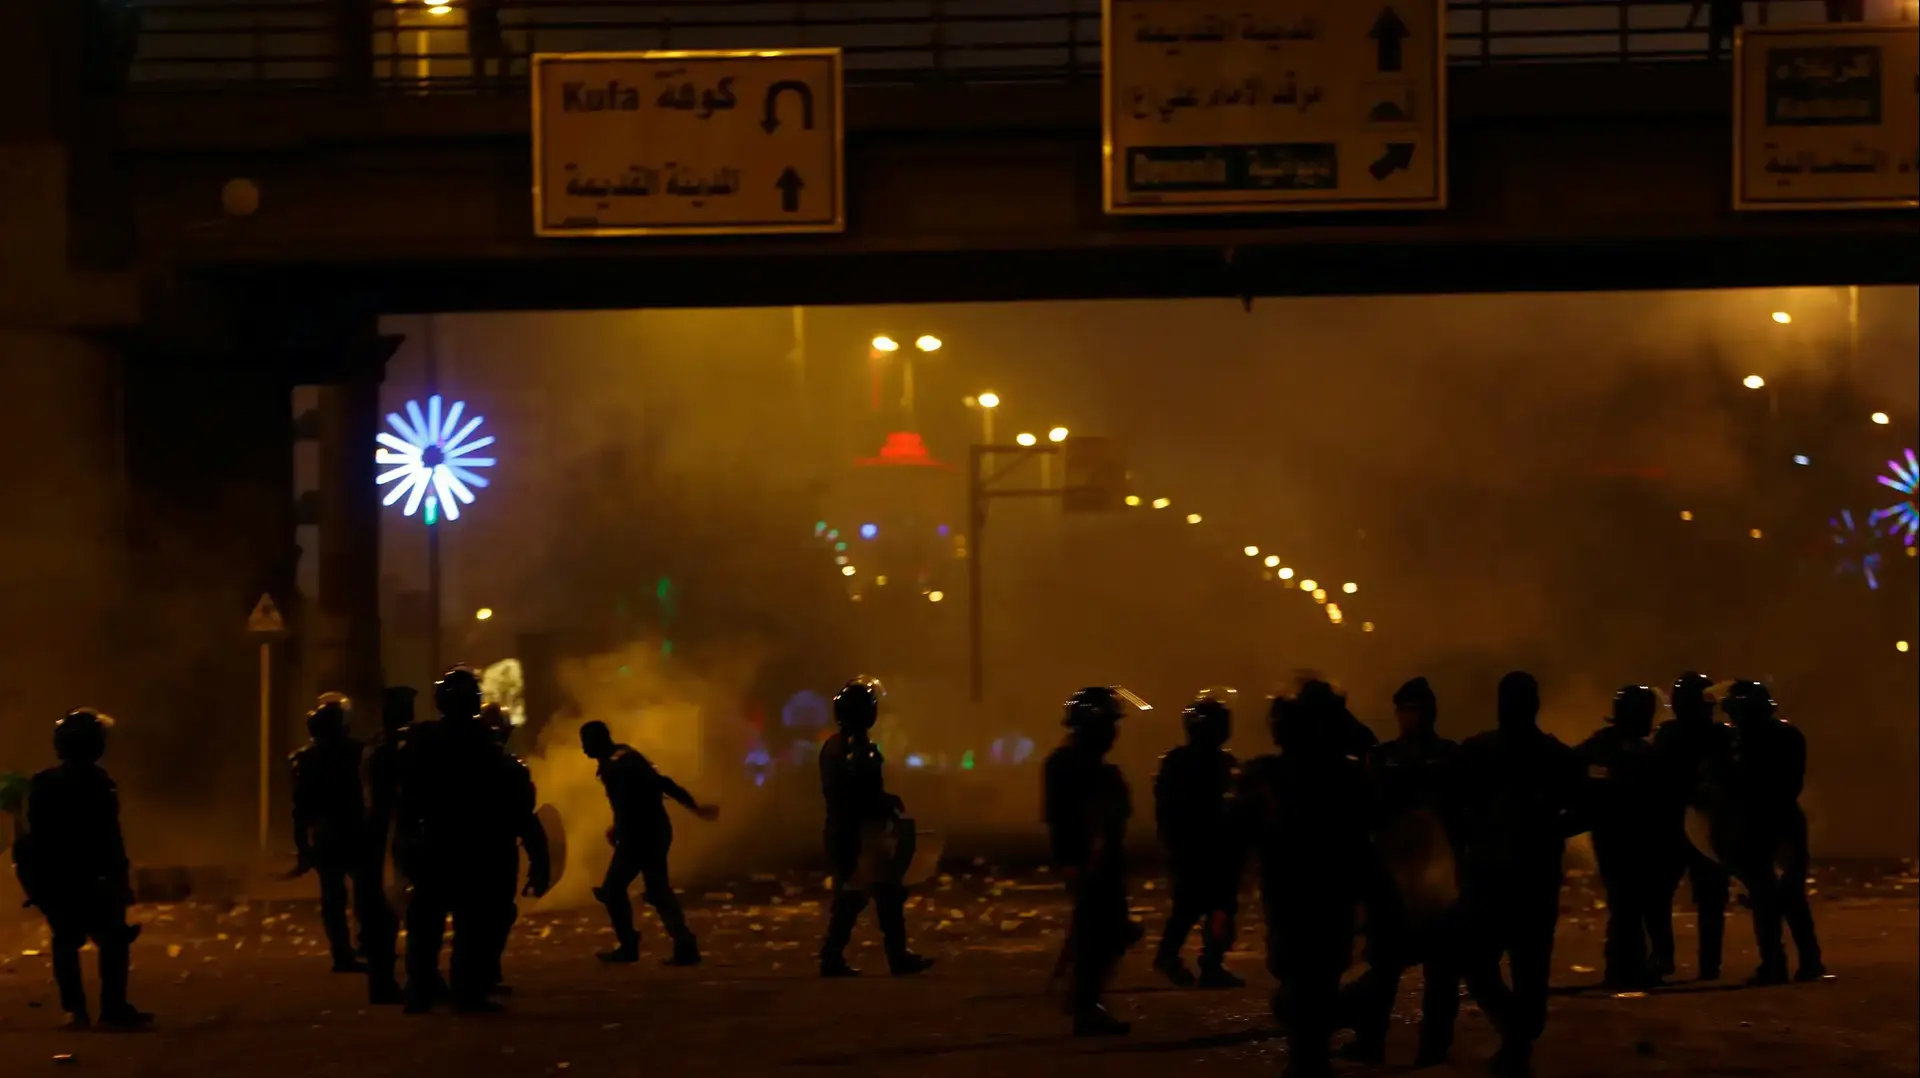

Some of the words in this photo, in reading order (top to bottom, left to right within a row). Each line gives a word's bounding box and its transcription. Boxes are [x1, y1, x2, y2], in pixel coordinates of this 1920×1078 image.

[562, 80, 640, 112] Kufa
[653, 68, 738, 119] كوفة
[563, 162, 661, 210] القديمة
[665, 160, 743, 209] المدينة
